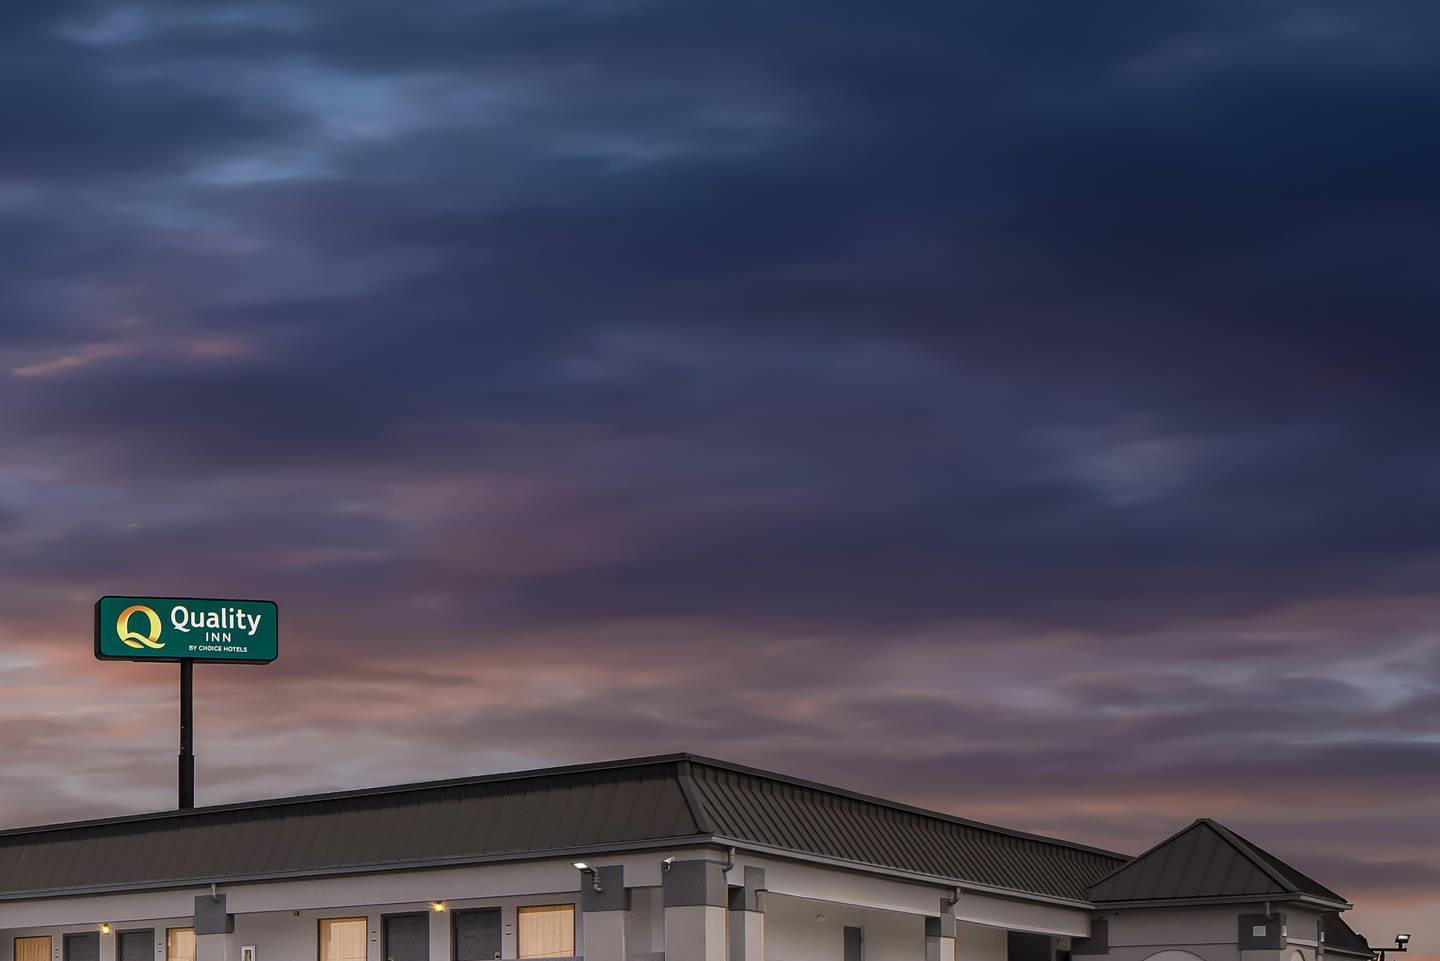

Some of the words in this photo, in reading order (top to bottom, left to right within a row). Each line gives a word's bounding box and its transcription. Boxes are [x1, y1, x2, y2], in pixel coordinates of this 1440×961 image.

[116, 605, 166, 649] Q
[170, 605, 262, 636] Quality
[205, 632, 231, 642] INN
